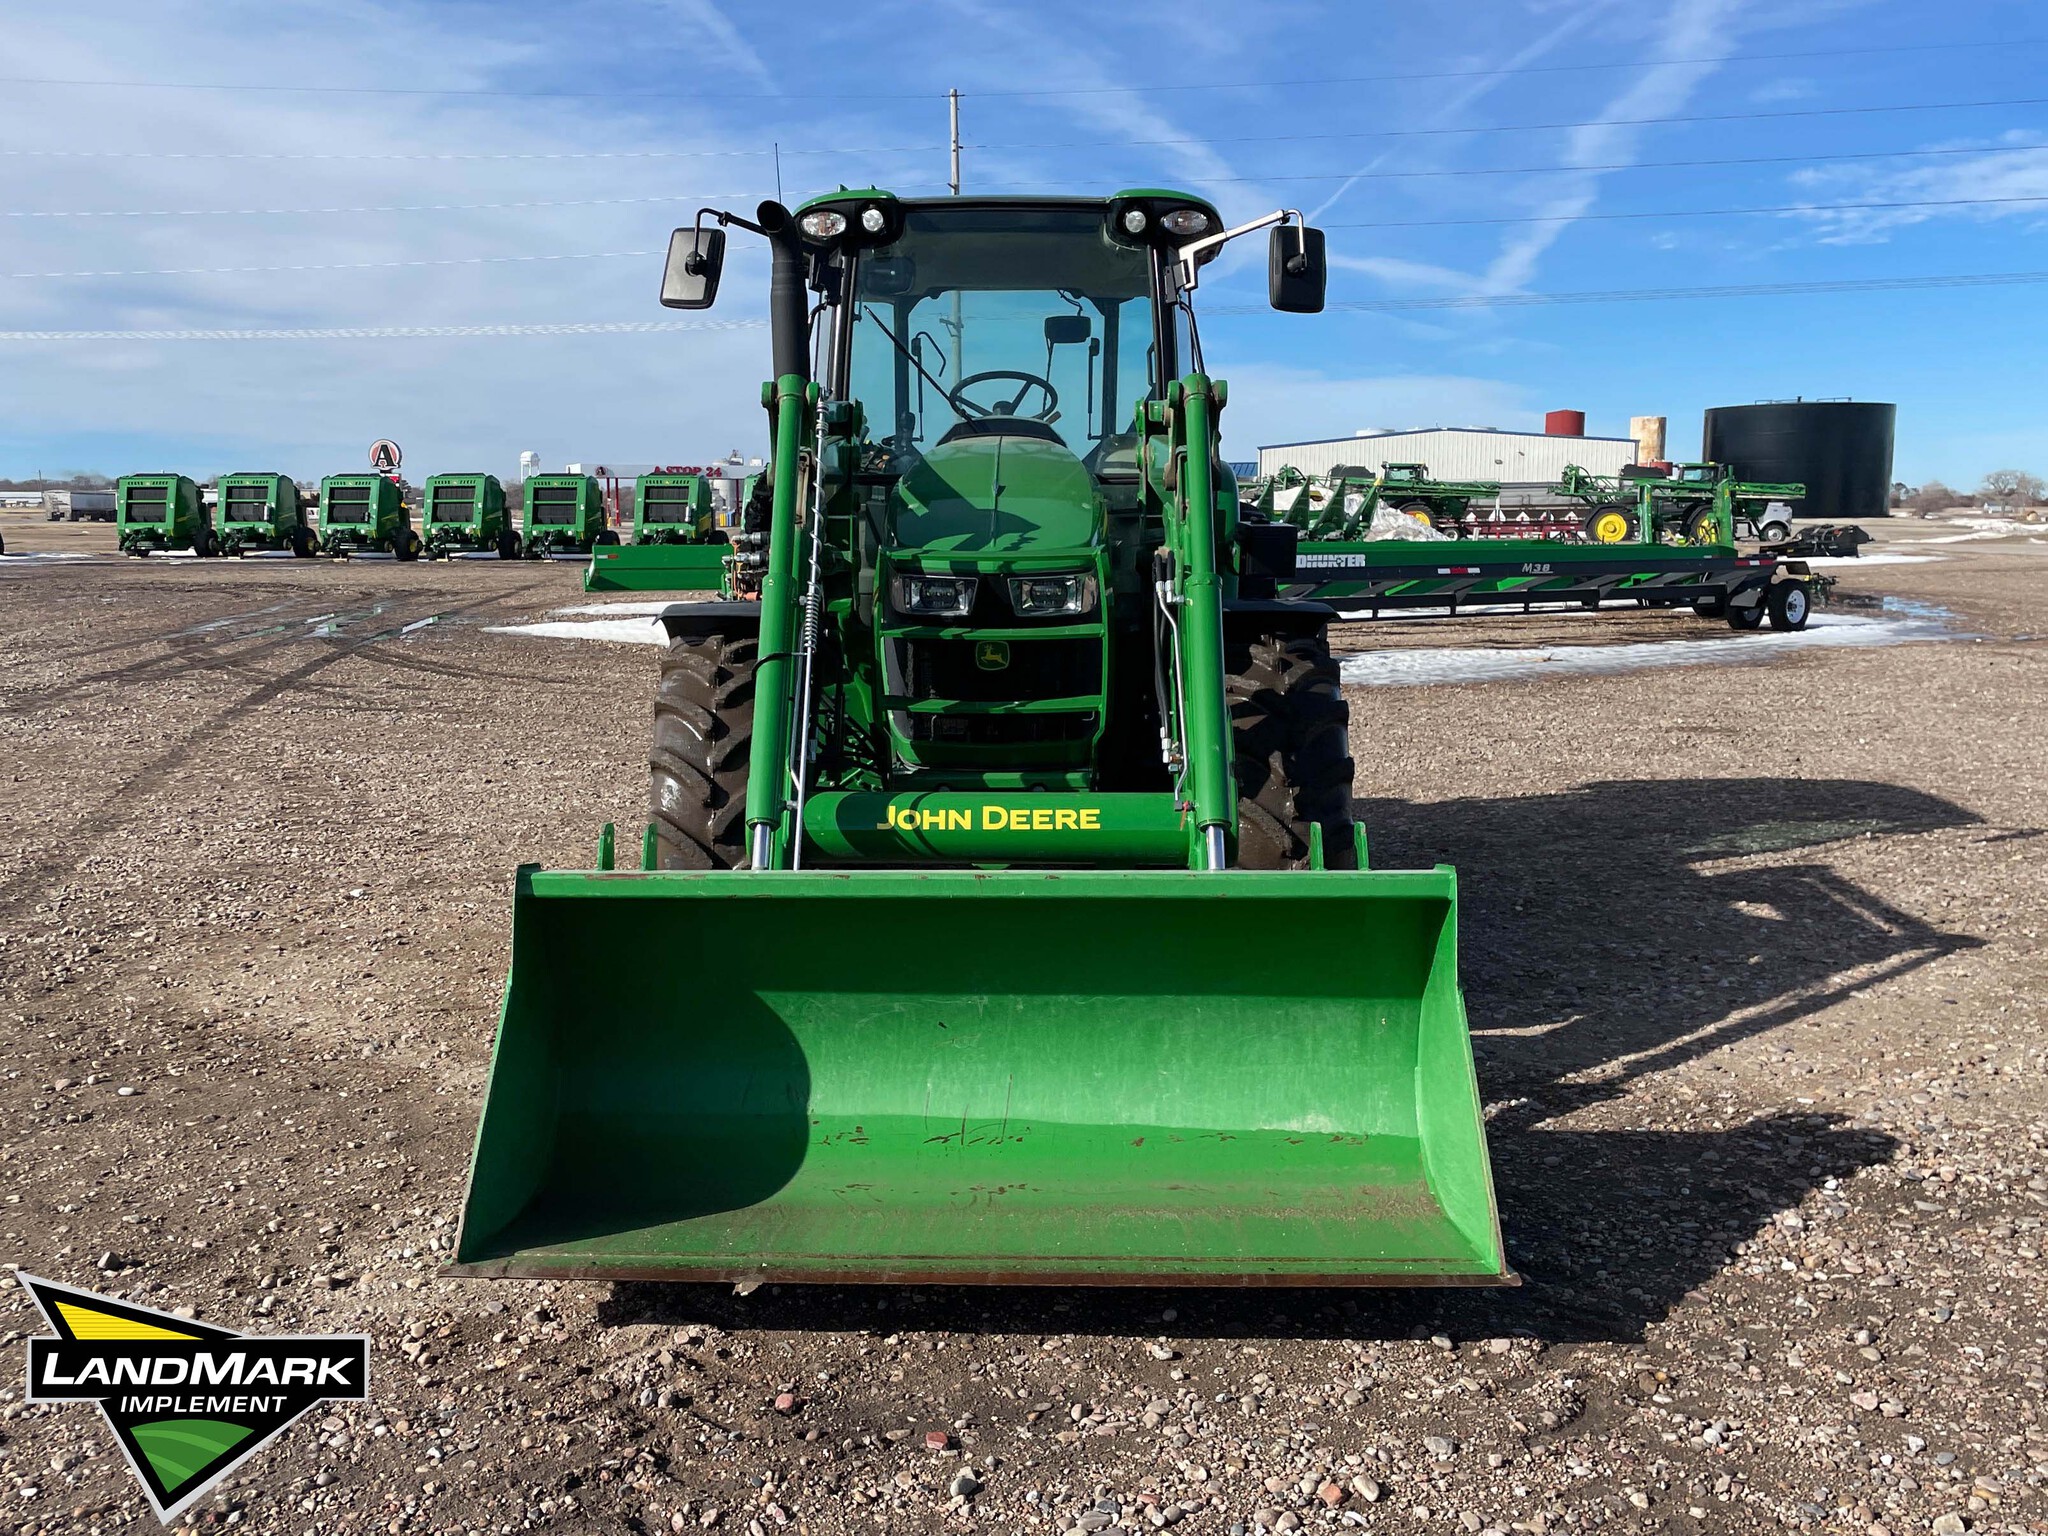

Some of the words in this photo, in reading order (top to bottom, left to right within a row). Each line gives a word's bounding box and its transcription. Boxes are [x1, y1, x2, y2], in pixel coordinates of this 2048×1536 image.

[373, 444, 399, 467] A
[666, 466, 702, 475] STOP
[706, 467, 723, 477] 24
[1521, 562, 1550, 574] M38
[877, 805, 972, 831] JOHN
[982, 805, 1101, 831] DEERE
